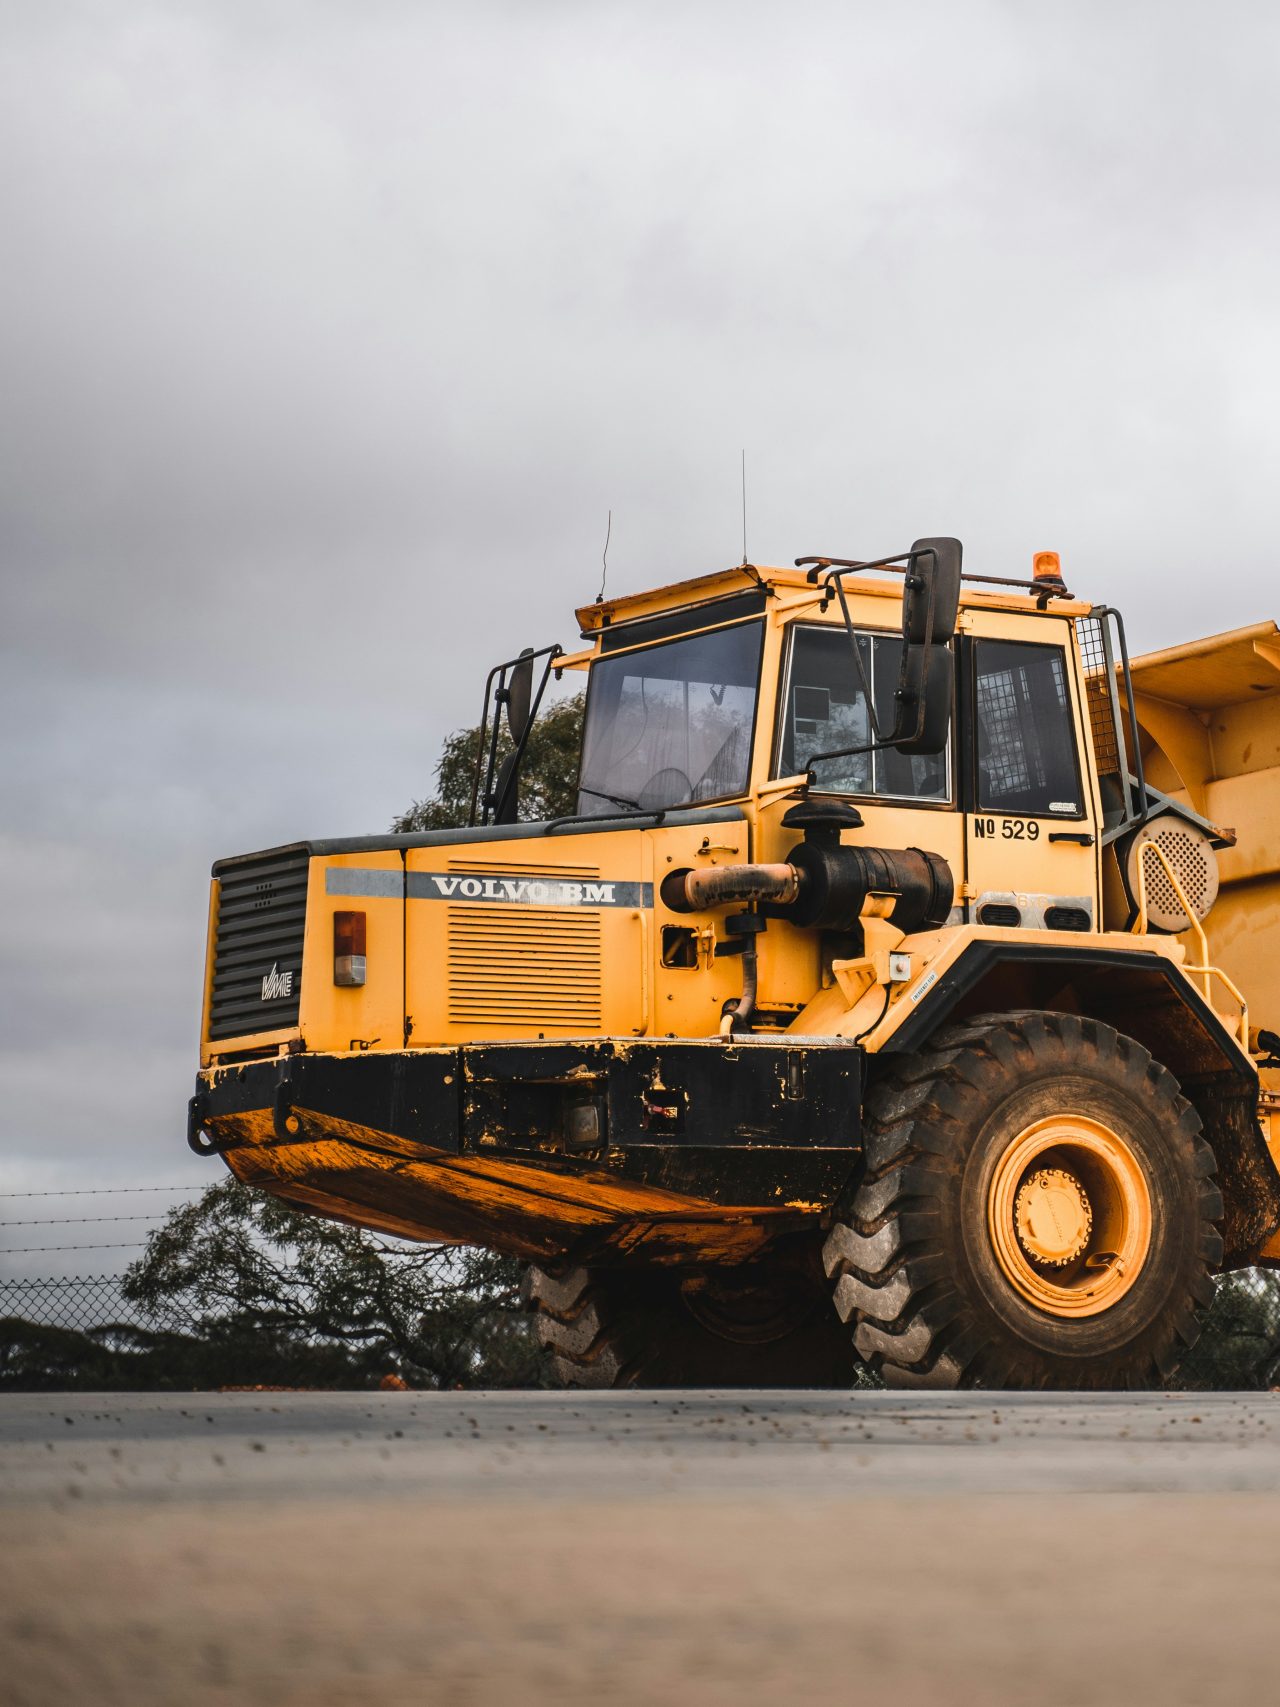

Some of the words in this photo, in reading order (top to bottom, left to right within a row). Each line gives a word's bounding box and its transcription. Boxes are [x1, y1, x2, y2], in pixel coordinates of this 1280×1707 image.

[1001, 819, 1040, 841] 529
[431, 876, 549, 902] VOLVO
[559, 883, 616, 903] BM
[261, 961, 293, 1001] VME
